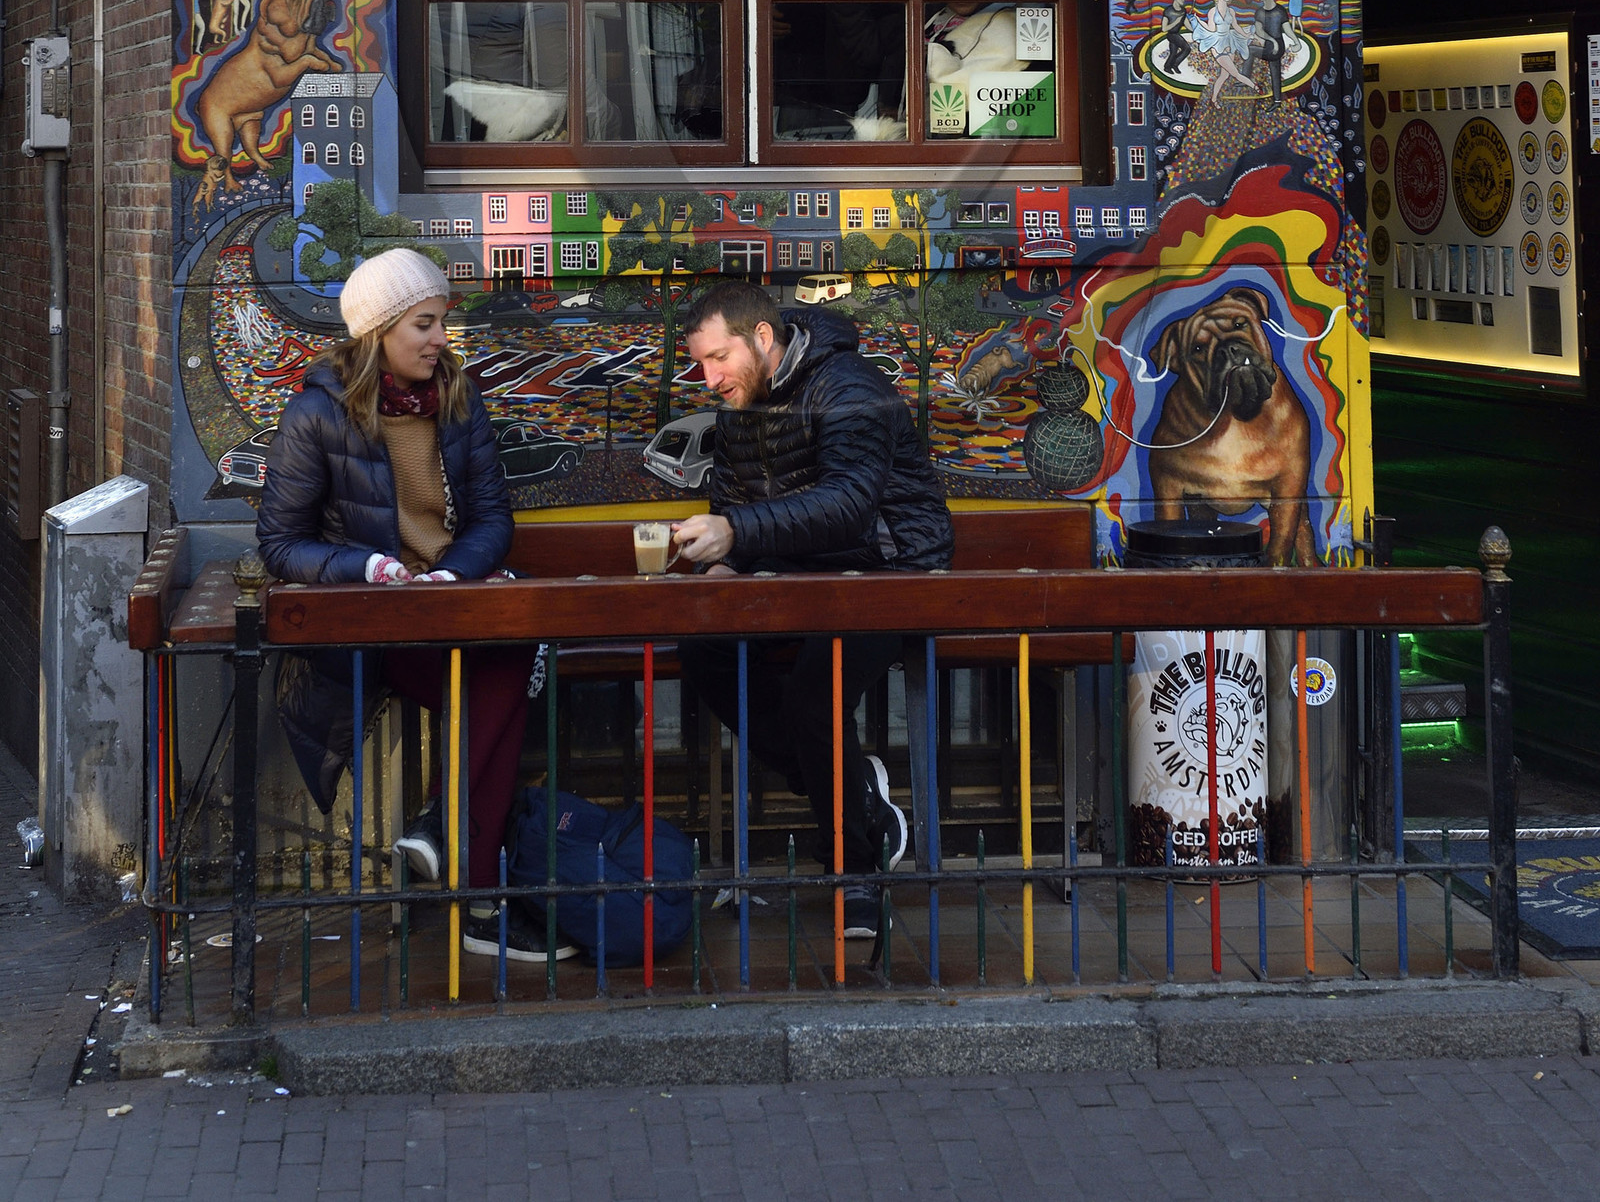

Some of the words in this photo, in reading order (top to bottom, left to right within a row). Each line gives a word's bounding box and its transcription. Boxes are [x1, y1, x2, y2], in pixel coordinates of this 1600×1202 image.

[1019, 8, 1049, 17] 2010
[976, 88, 1047, 102] COFFEE
[988, 103, 1036, 117] SHOP
[936, 119, 960, 127] BCD
[1455, 134, 1469, 159] THE
[1470, 124, 1508, 163] BULLDOG
[1150, 661, 1190, 715] THE
[1171, 831, 1207, 846] CED
